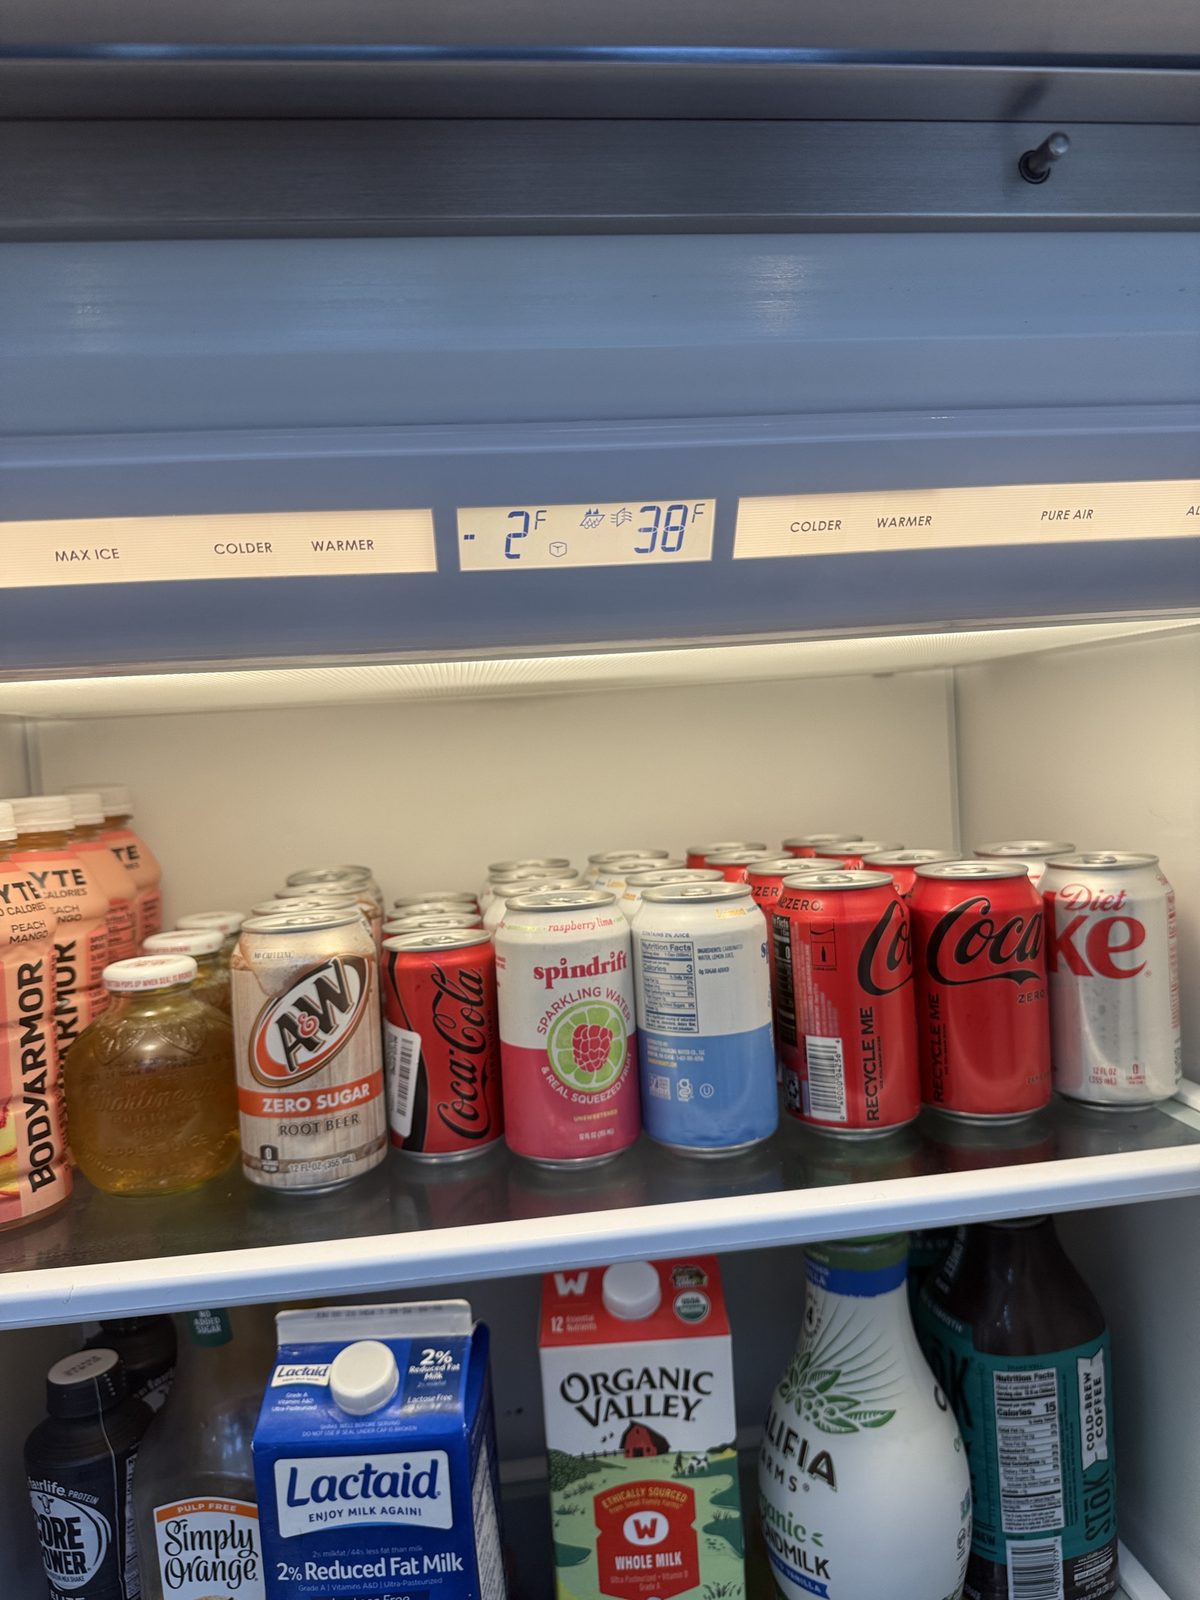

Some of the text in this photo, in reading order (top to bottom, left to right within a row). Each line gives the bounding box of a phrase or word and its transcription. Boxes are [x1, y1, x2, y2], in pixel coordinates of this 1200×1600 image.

[875, 515, 933, 529] WARMER
[1040, 509, 1094, 521] PURE AIR
[790, 519, 842, 533] COLDER
[54, 548, 120, 562] MAX ICE
[213, 541, 273, 556] COLDER
[311, 539, 375, 552] WARMER
[111, 845, 140, 862] TE
[29, 868, 88, 889] YTE
[1060, 883, 1128, 912] Diet
[9, 930, 48, 944] MANGO
[11, 920, 46, 933] PEACH
[548, 920, 596, 934] raspberry
[1042, 890, 1148, 979] ke
[641, 942, 692, 952] Nutrition Facts
[533, 950, 627, 989] spindrift
[687, 964, 693, 973] 3
[275, 956, 355, 1072] A&W
[537, 986, 601, 1035] SPARKLING
[605, 987, 631, 1022] WATER
[928, 993, 946, 1102] RECYCLE ME
[860, 1006, 880, 1121] RECYCLE ME
[17, 958, 57, 1193] BODYARMOR
[546, 1072, 569, 1099] REAL
[570, 1082, 622, 1105] SQUEEZED
[621, 1052, 632, 1083] FRUIT
[263, 1083, 371, 1113] ZERO SUGAR
[279, 1113, 361, 1136] ROOT BEER
[553, 1271, 589, 1297] W
[551, 1316, 564, 1333] 12
[420, 1348, 453, 1366] 2%
[277, 1365, 329, 1378] Lactaid
[408, 1364, 446, 1374] Reduced
[996, 1371, 1055, 1383] Nutrition Facts
[560, 1367, 714, 1404] ORGANIC
[575, 1395, 703, 1427] VALLEY
[997, 1401, 1057, 1417] Calories 15
[1083, 1372, 1094, 1451] COLD-BREW
[1093, 1377, 1104, 1438] COFFEE
[286, 1458, 438, 1507] Lactaid
[67, 1489, 100, 1505] PROTEIN
[602, 1486, 689, 1509] ETHICALLY SOURCED
[177, 1503, 237, 1513] PULP FREE
[308, 1506, 422, 1522] ENJOY MILK AGAIN!
[38, 1514, 84, 1550] ORE
[164, 1519, 259, 1559] Simply
[633, 1518, 658, 1539] W
[42, 1547, 88, 1575] OWER
[276, 1552, 464, 1581] 2% Reduced Fat Milk
[615, 1552, 682, 1571] WHOLE MILK
[164, 1556, 256, 1590] Orange
[331, 1582, 361, 1591] Vitamins
[362, 1581, 379, 1589] A&D
[384, 1576, 443, 1588] Ultra-Pasteurized
